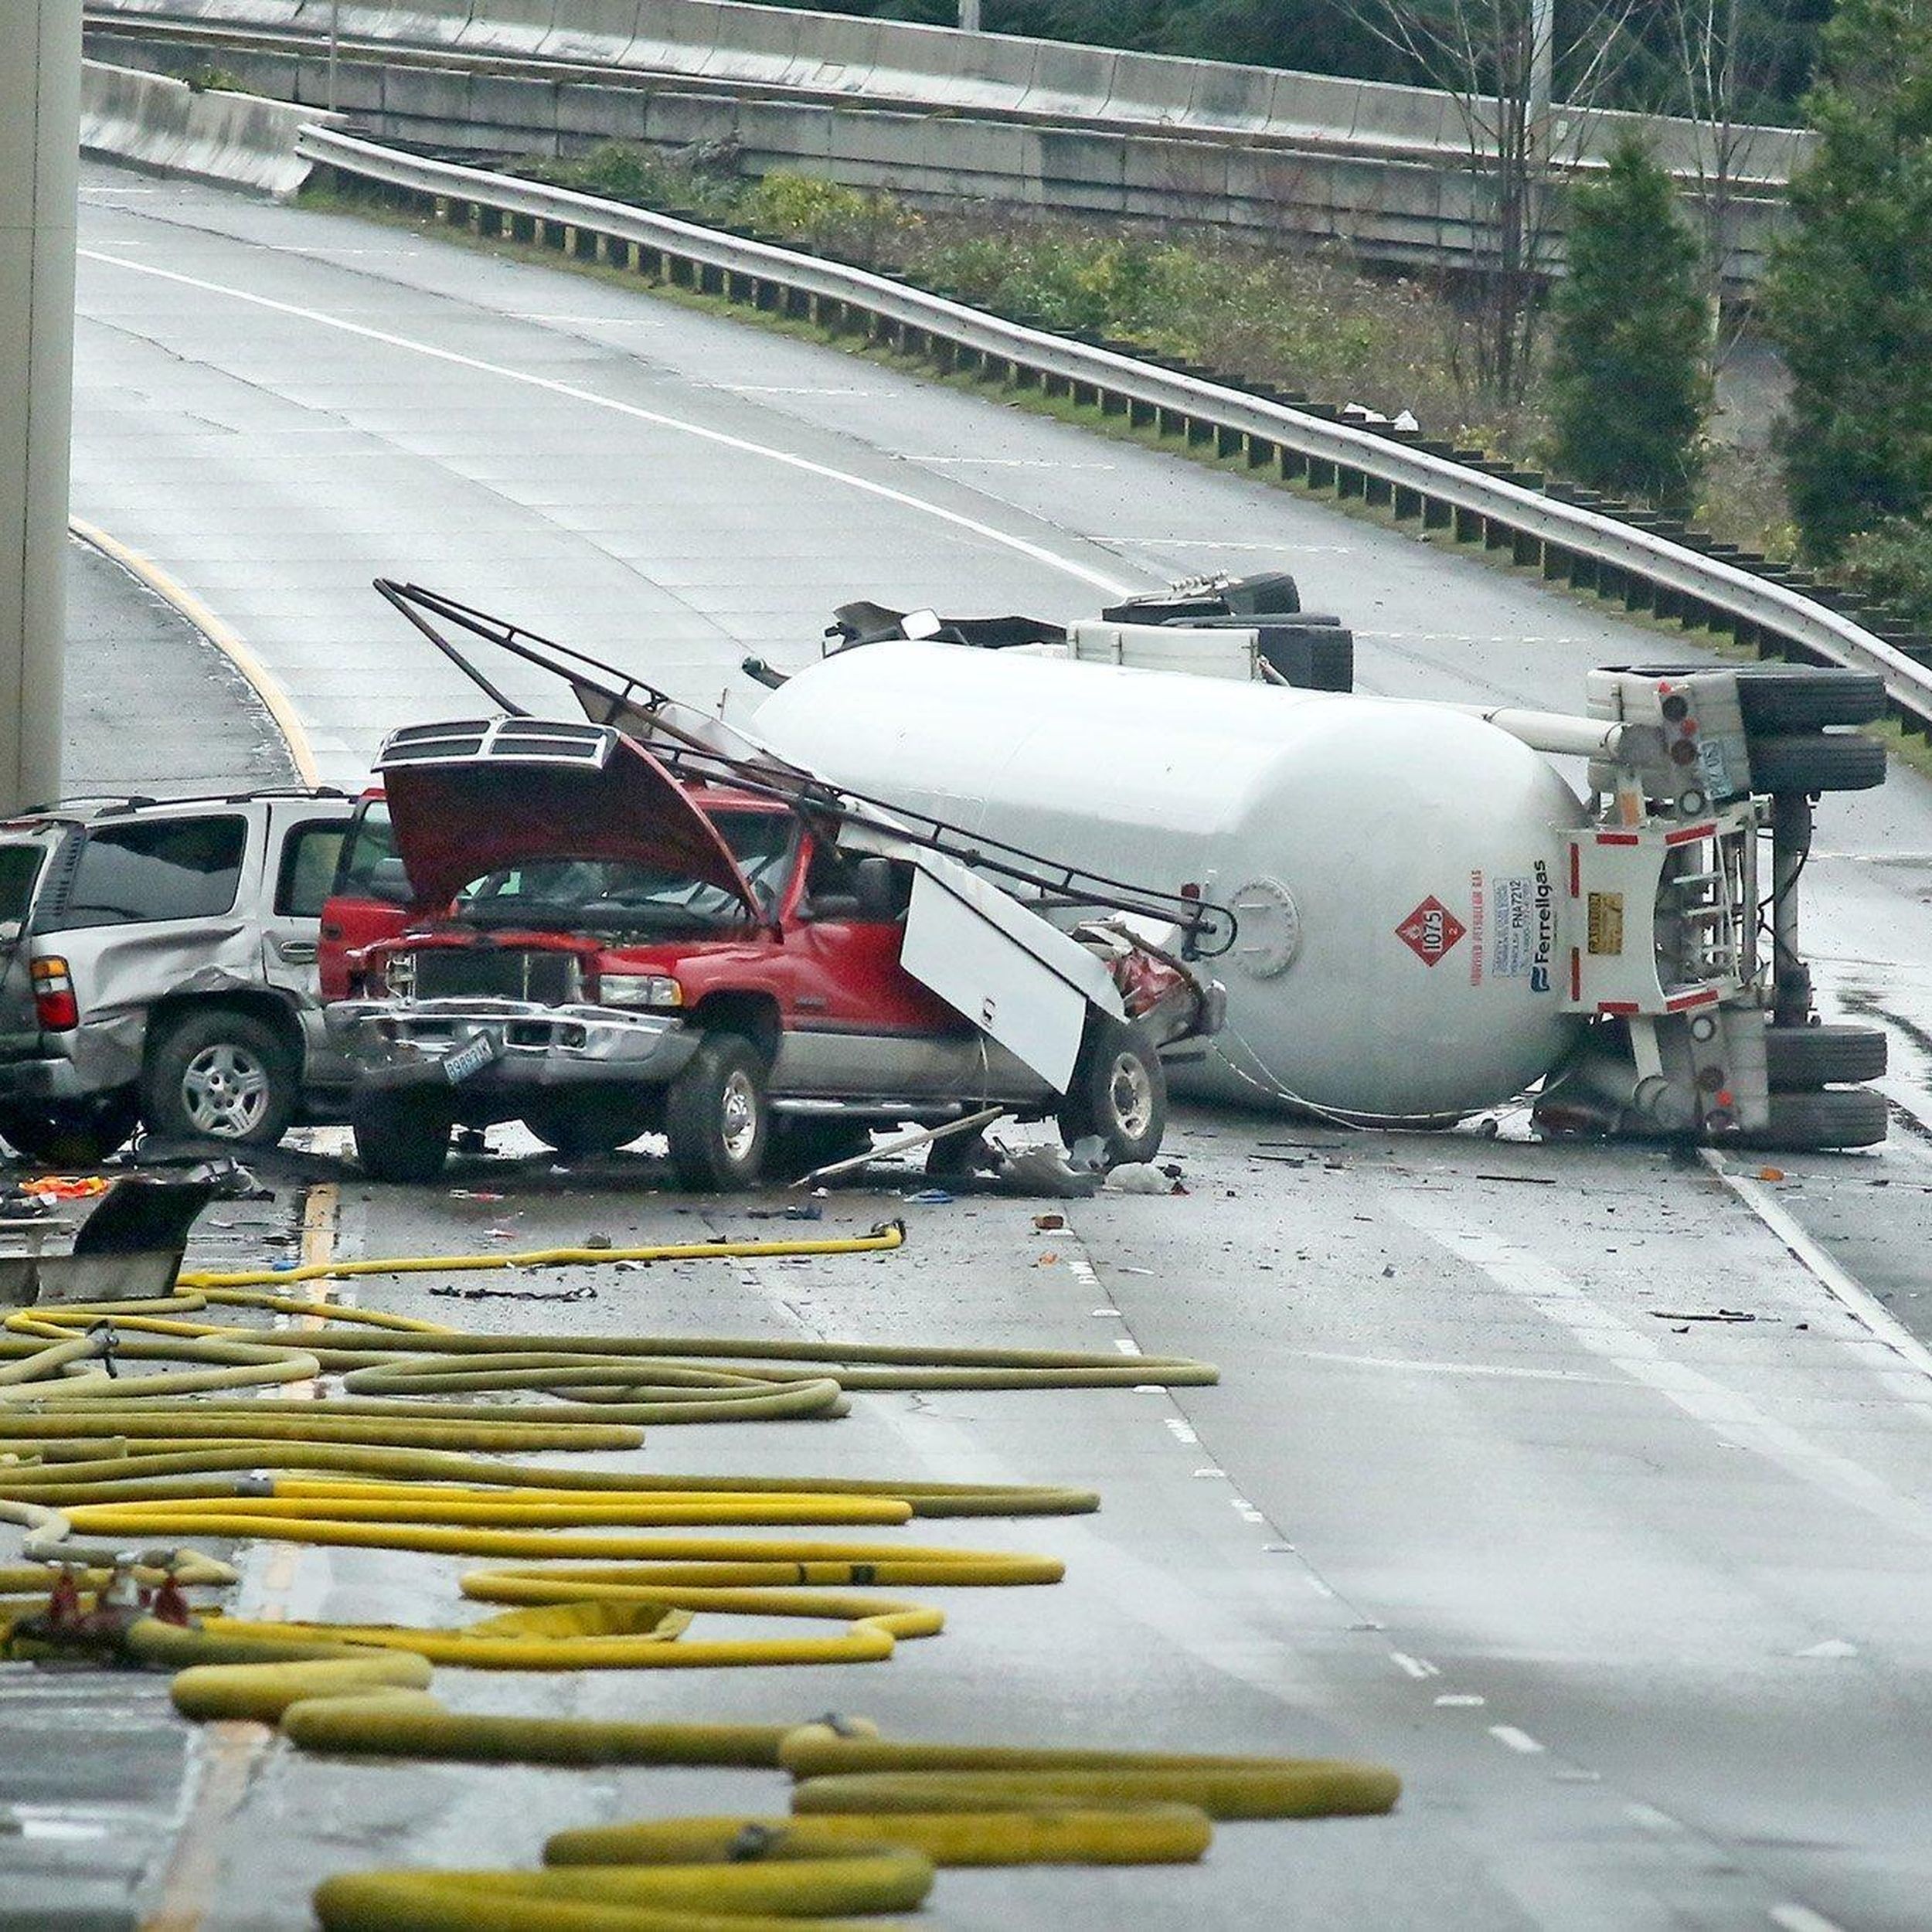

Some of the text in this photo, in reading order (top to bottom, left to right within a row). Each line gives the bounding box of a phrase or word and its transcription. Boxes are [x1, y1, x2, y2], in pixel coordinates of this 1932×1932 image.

[1471, 870, 1483, 888] GAS
[1509, 879, 1523, 928] FNA7212
[1534, 859, 1553, 963] Ferrellgas
[1423, 913, 1441, 949] 1075
